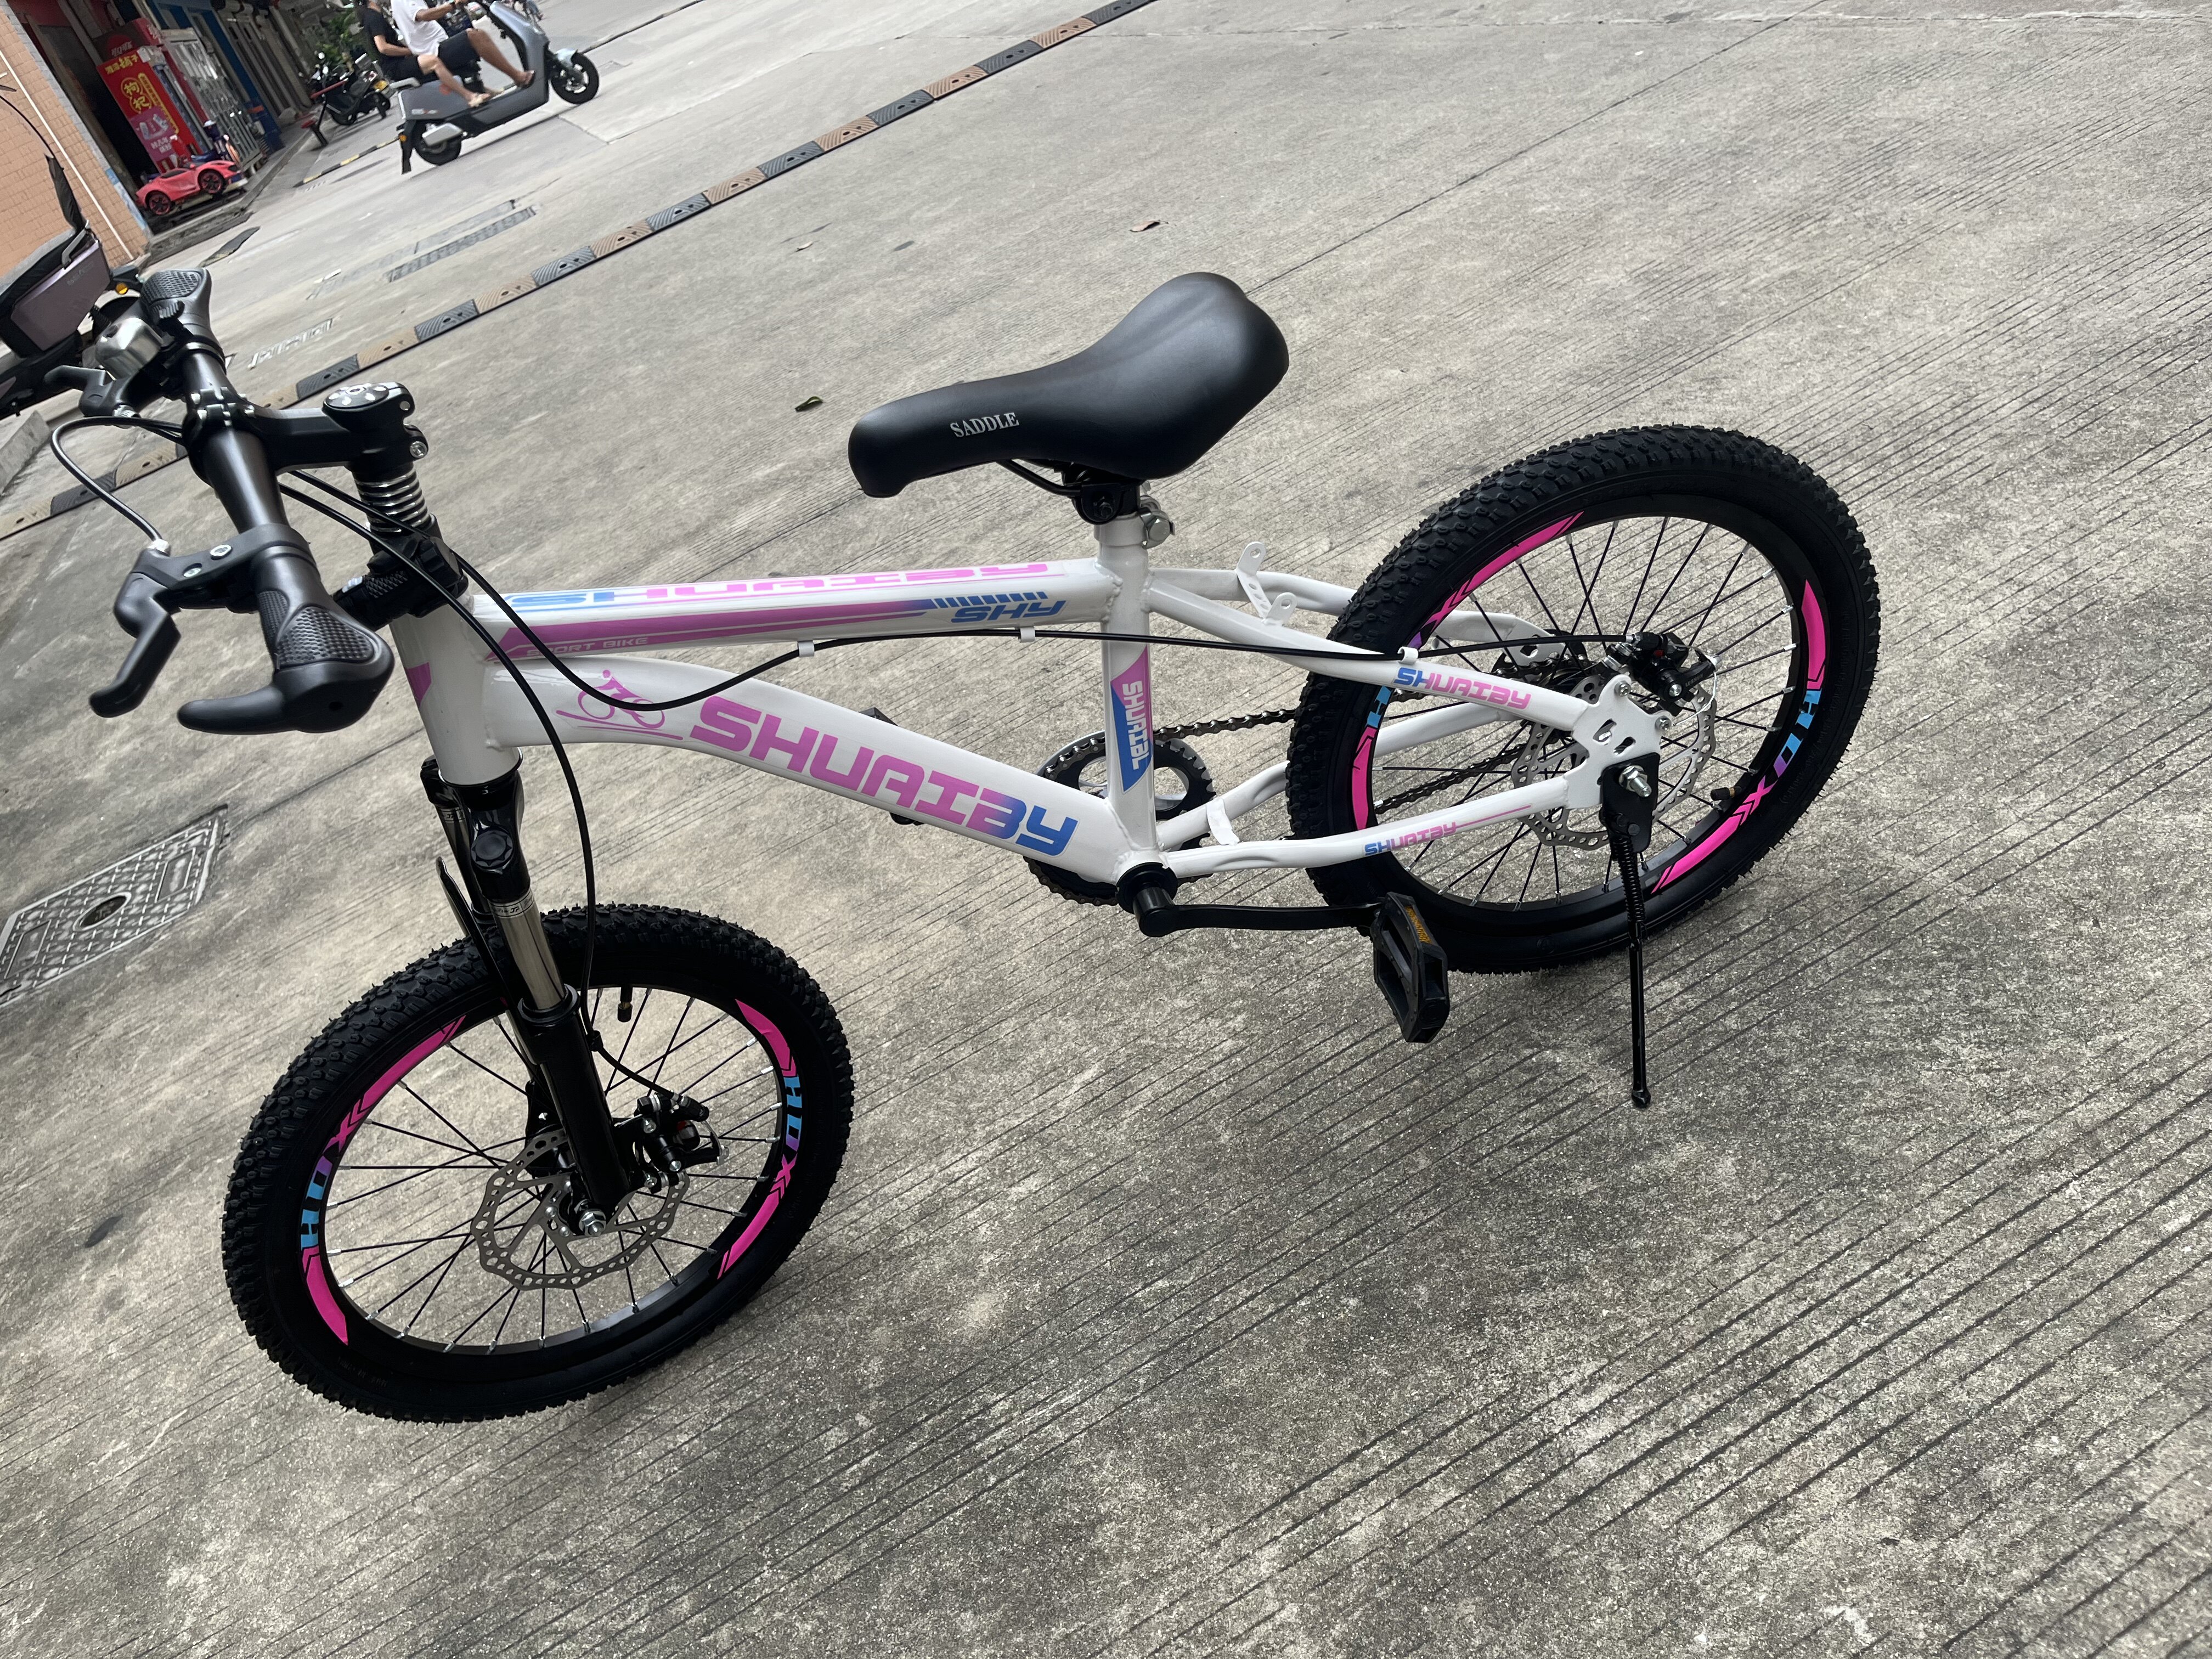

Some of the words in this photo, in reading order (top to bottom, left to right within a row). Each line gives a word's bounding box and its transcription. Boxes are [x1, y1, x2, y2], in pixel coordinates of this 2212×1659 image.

[950, 411, 1020, 438] SADDLE
[951, 600, 1066, 623] SHY
[603, 637, 648, 649] BIKE
[1393, 667, 1531, 710] SHUAIBY
[689, 695, 1077, 856] SHUAIBY
[1364, 822, 1457, 856] SHUAIBY
